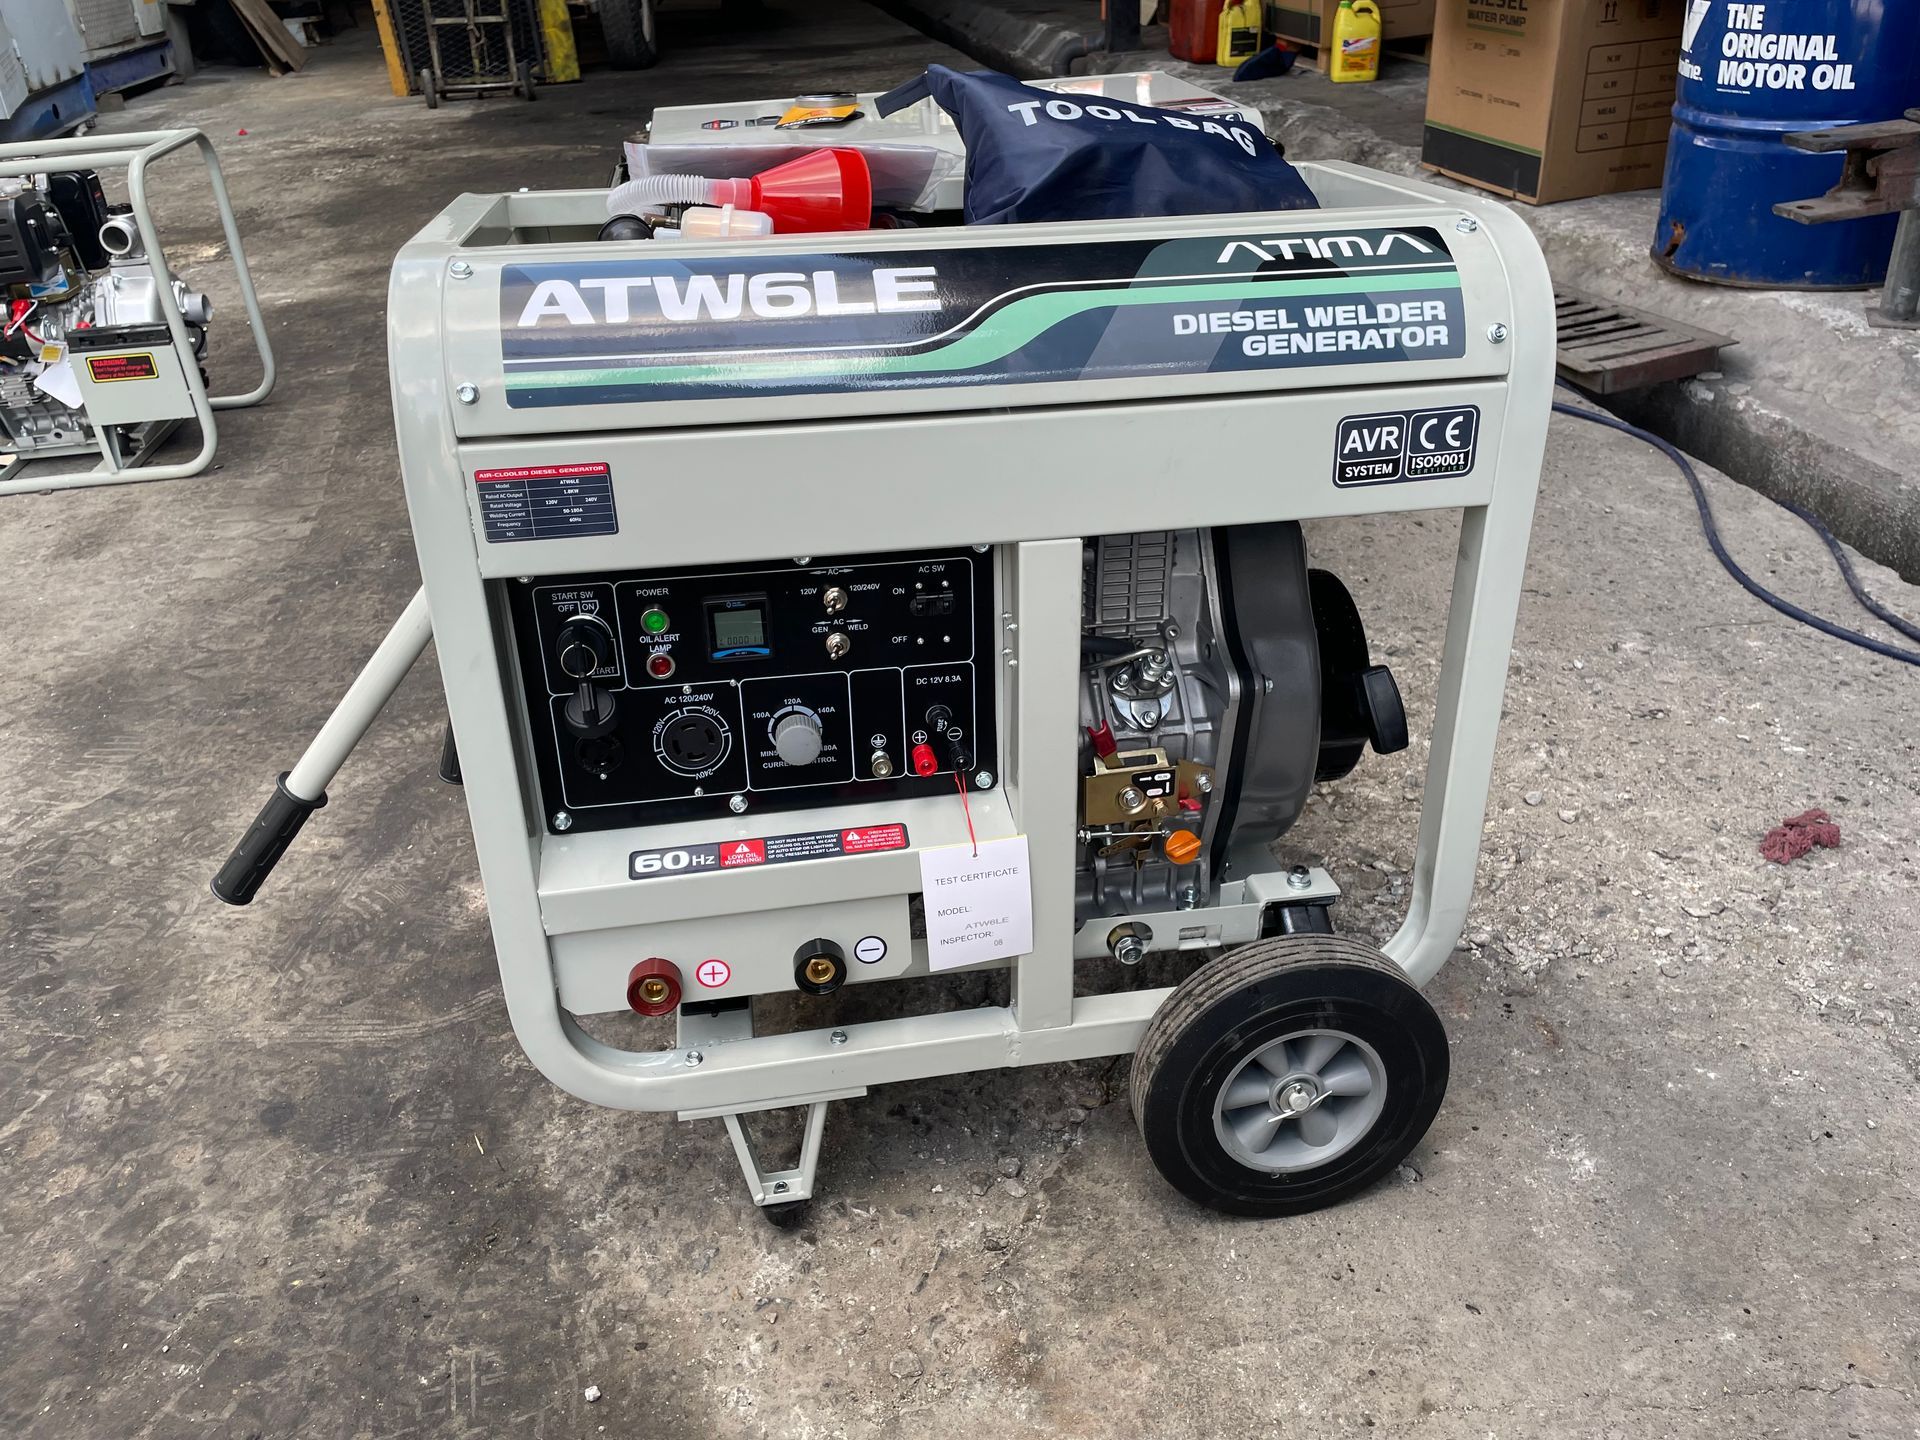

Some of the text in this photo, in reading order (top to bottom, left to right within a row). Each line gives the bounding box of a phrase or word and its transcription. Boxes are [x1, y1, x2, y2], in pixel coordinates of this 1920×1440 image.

[1467, 10, 1526, 27] WATER PUMP
[1727, 4, 1766, 30] THE
[1722, 32, 1839, 61] ORIGINAL
[1717, 60, 1806, 90] MOTOR
[1812, 64, 1856, 91] OIL
[1008, 100, 1256, 158] TOOL BAG
[1216, 233, 1434, 264] ATIMA
[517, 266, 942, 328] ATW6LE
[1173, 301, 1447, 336] DIESEL WELDER
[1242, 325, 1449, 357] GENERATOR
[1343, 426, 1399, 454] AVR
[1420, 416, 1464, 450] CE
[1411, 453, 1465, 469] ISO9001
[479, 470, 529, 478] AIR-CLOOLED
[1345, 463, 1393, 478] SYSTEM
[1410, 465, 1464, 475] CERTIFIED
[552, 591, 594, 601] START SW
[636, 588, 670, 597] POWER
[800, 583, 880, 596] 120V 120/240V
[892, 587, 905, 595] ON
[558, 602, 594, 613] OFF ON
[640, 633, 680, 644] OIL ALERT
[892, 636, 908, 644] OFF
[650, 644, 672, 653] LAMP
[944, 674, 962, 683] 8.3A
[678, 693, 714, 703] 120/240V
[702, 704, 720, 718] 120V
[652, 718, 666, 735] 120V
[695, 768, 714, 780] 240V
[724, 857, 762, 866] WARNING!
[935, 866, 1019, 886] TEST CERTIFICATE
[938, 906, 972, 918] MODEL:
[965, 916, 1009, 930] ATW6LE
[940, 930, 994, 946] INSPECTOR:
